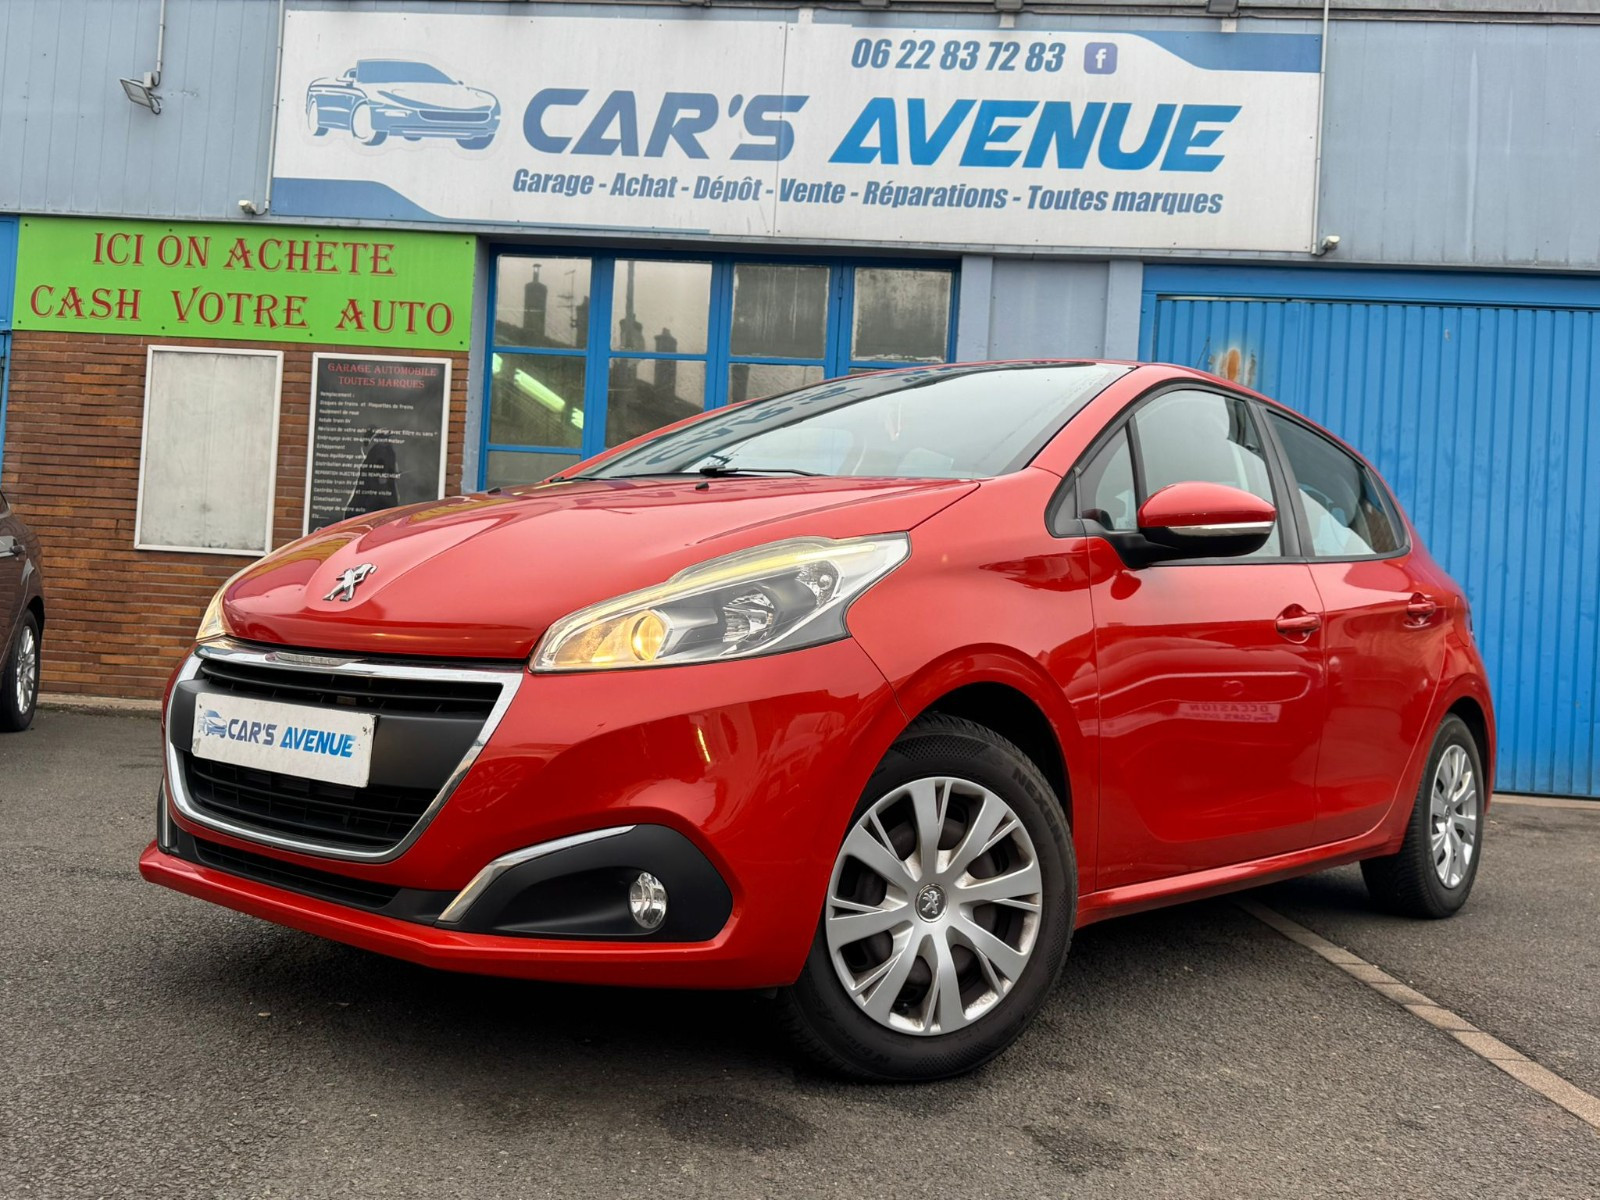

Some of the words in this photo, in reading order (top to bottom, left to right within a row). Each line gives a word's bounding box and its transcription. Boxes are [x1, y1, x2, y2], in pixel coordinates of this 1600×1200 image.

[851, 38, 890, 69] 06
[895, 39, 933, 69] 22
[939, 40, 981, 70] 83
[987, 41, 1021, 71] 72
[1024, 42, 1066, 73] 83
[522, 88, 810, 162] CAR'S
[828, 97, 1242, 172] AVENUE
[513, 168, 594, 197] Garage
[610, 172, 678, 198] Achat
[693, 175, 763, 203] Dépôt
[779, 178, 846, 204] Vente
[863, 181, 1008, 209] Réparations
[1028, 185, 1108, 211] Toutes
[1112, 192, 1223, 216] marques
[93, 233, 144, 267] ICI
[157, 235, 211, 269] ON
[223, 238, 397, 277] ACHETE
[30, 285, 142, 321] CASH
[171, 286, 309, 329] VOTRE
[336, 298, 455, 334] AUTO
[327, 363, 371, 373] GARAGE
[374, 365, 437, 376] AUTOMOBILE
[338, 376, 375, 386] TOUTES
[377, 378, 425, 388] MARQUES
[227, 718, 278, 746] CAR'S
[280, 726, 357, 758] AVENUE
